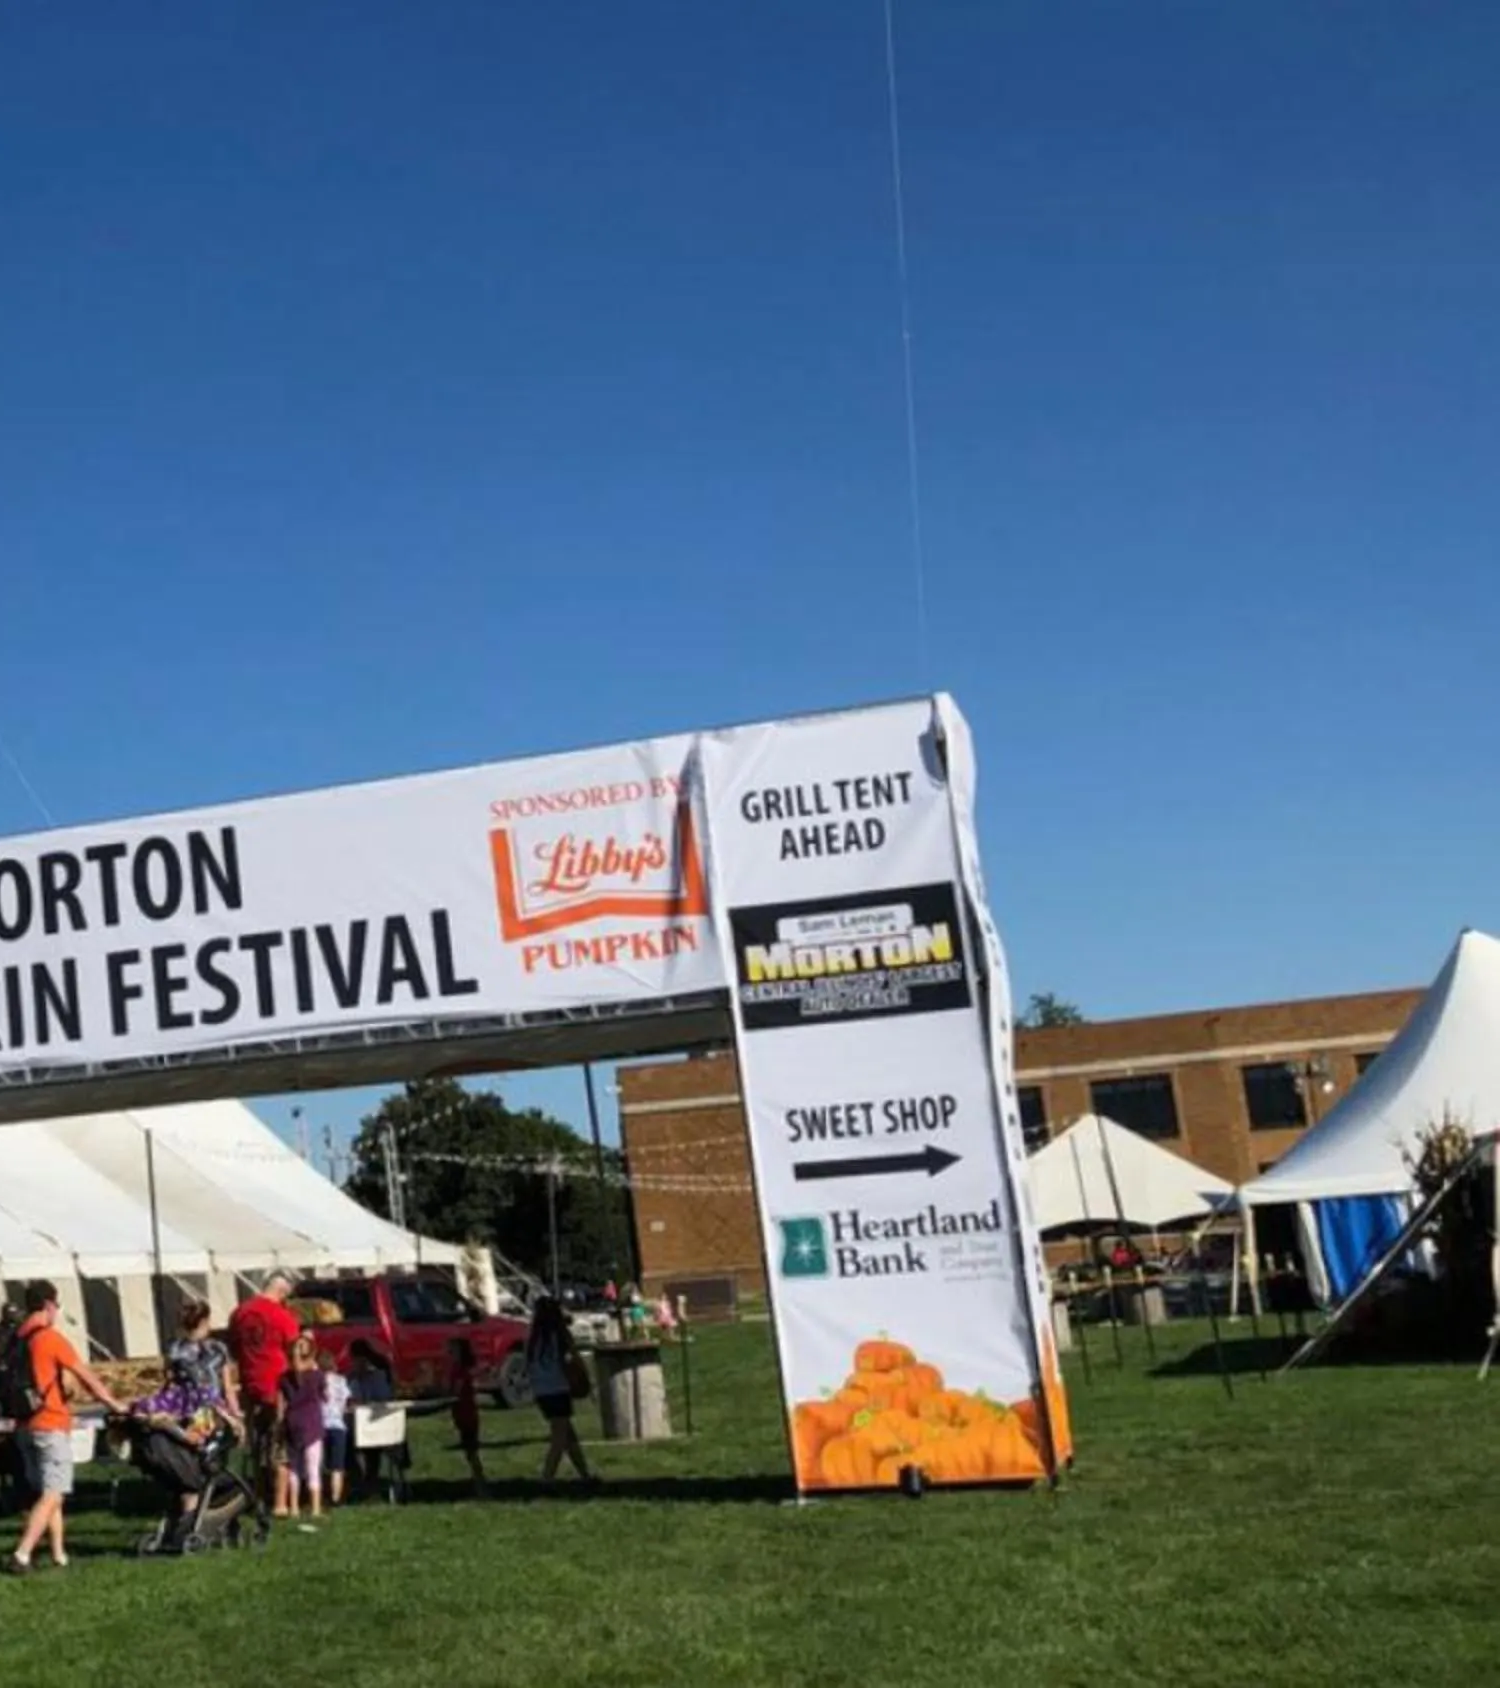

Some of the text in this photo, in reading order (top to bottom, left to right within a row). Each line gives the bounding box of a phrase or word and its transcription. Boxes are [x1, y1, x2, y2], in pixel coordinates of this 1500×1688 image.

[488, 780, 644, 819] SPONSORED
[740, 770, 912, 824] GRILL TENT
[527, 832, 666, 895] Libby's
[779, 816, 887, 861] AHEAD
[106, 909, 480, 1037] FESTIVAL
[522, 925, 697, 975] PUMPKIN
[745, 922, 953, 982] MORTON
[785, 1093, 958, 1143] SWEET SHOP
[829, 1199, 1003, 1244] Heartland
[835, 1241, 928, 1279] Bank
